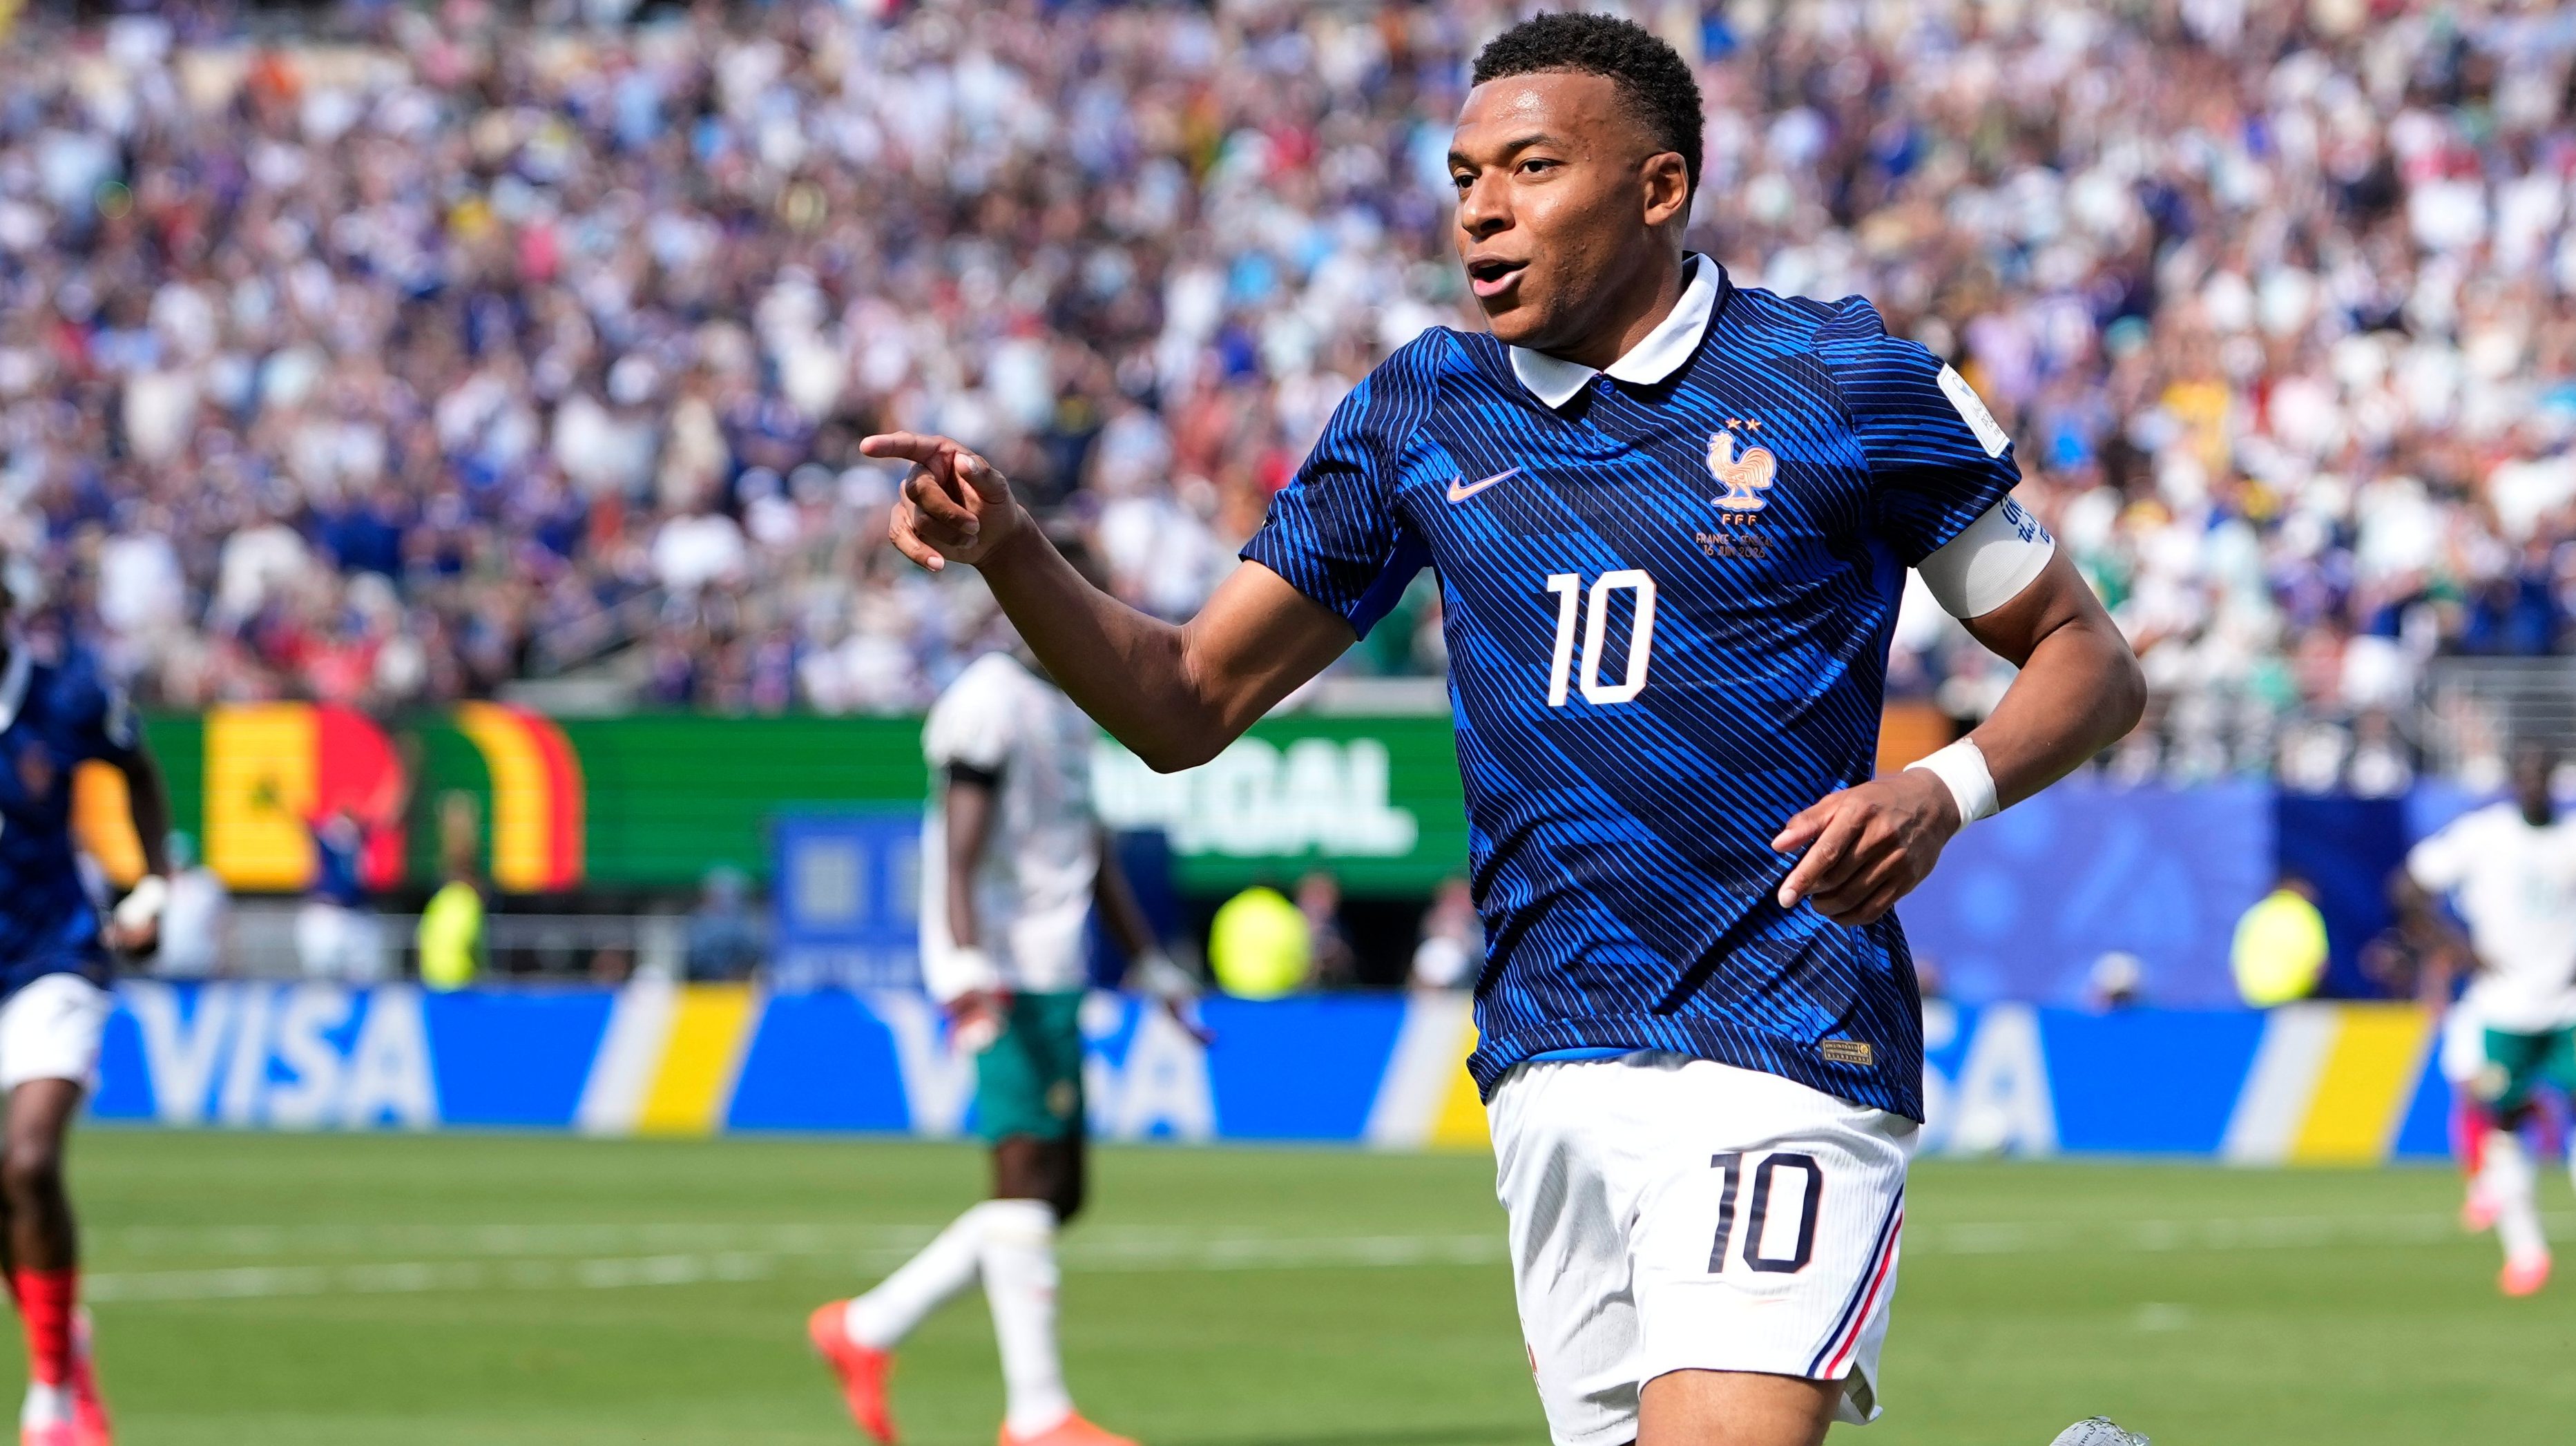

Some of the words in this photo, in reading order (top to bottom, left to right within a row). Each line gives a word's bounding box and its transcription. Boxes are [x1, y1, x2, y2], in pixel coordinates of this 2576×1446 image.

[1695, 532, 1729, 544] FRANCE
[1704, 545, 1714, 556] 16
[1722, 514, 1757, 526] FFF
[1547, 569, 1657, 706] 10
[117, 981, 443, 1131] VISA
[1707, 1151, 1824, 1274] 10
